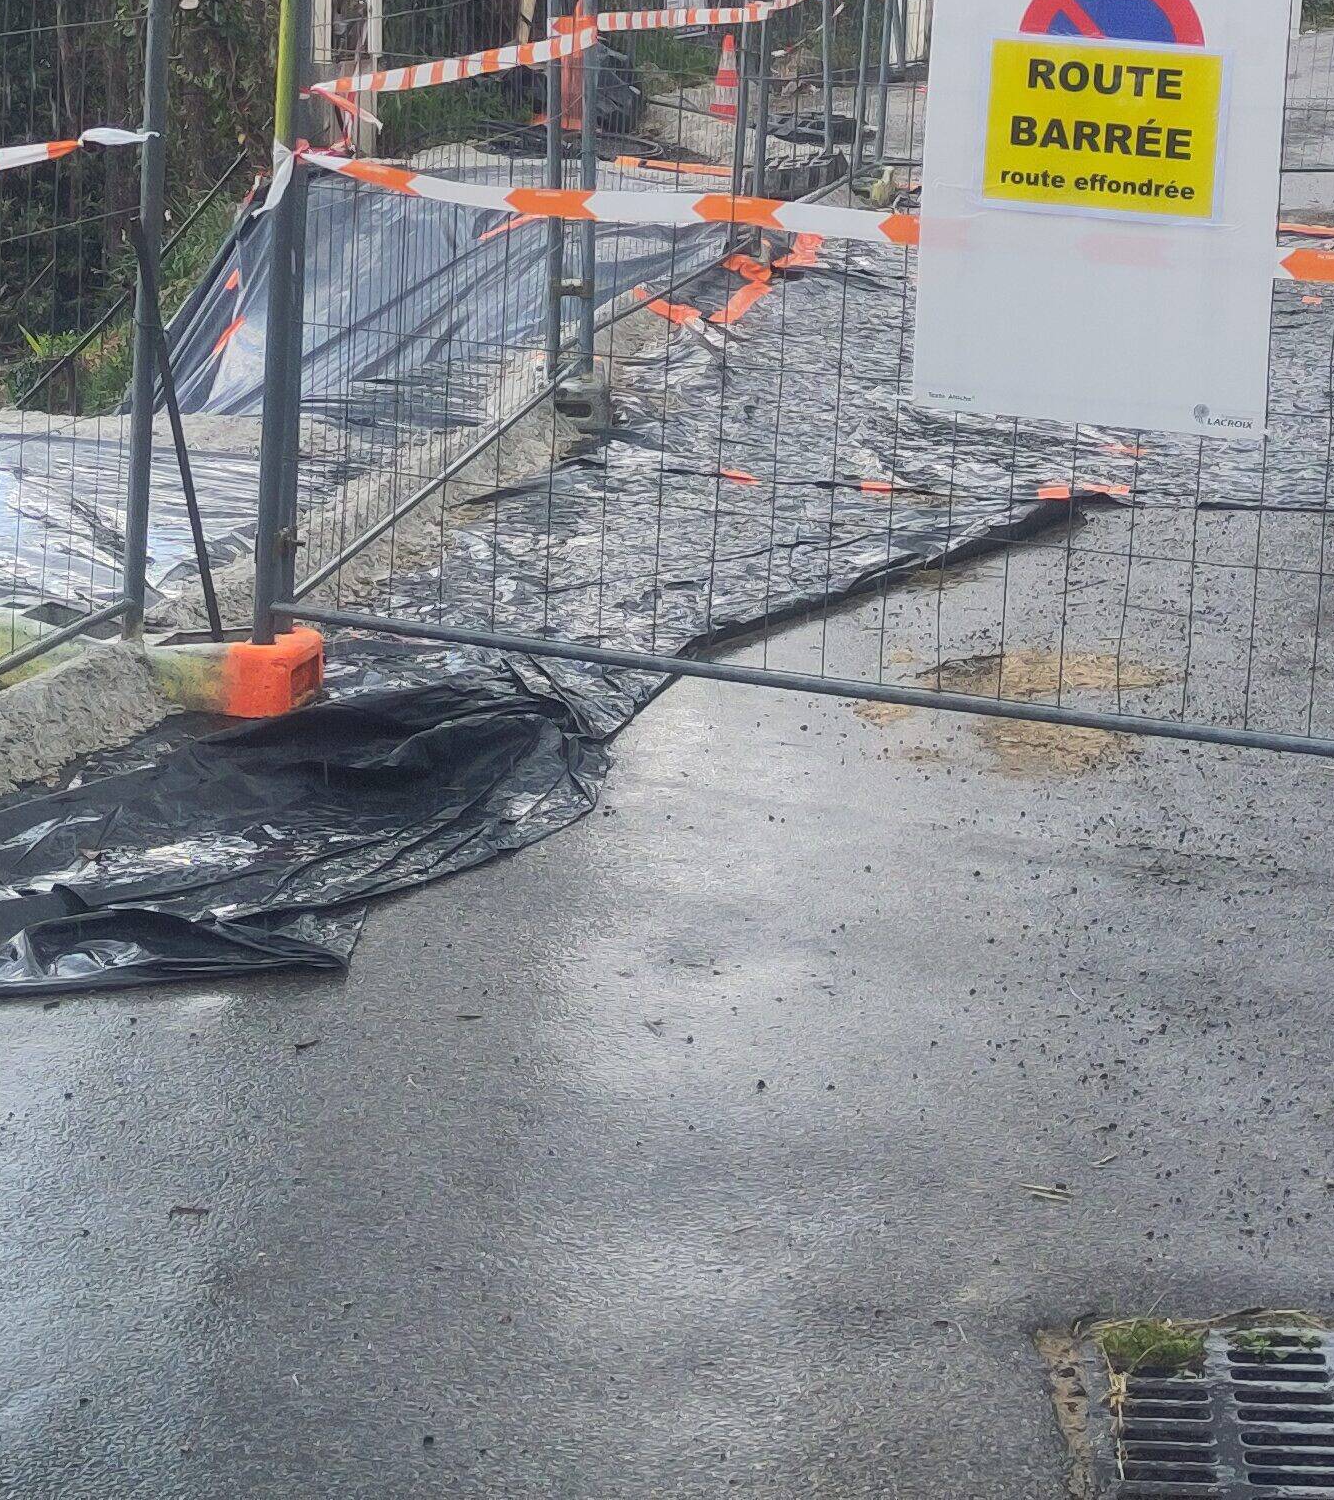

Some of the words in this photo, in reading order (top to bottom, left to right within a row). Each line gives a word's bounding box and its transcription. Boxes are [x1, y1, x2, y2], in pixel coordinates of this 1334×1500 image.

[1027, 58, 1183, 100] ROUTE
[1010, 115, 1193, 160] BARRÉE
[1000, 169, 1066, 188] route
[1074, 173, 1195, 200] effondrée
[1207, 417, 1254, 430] LACROIX
